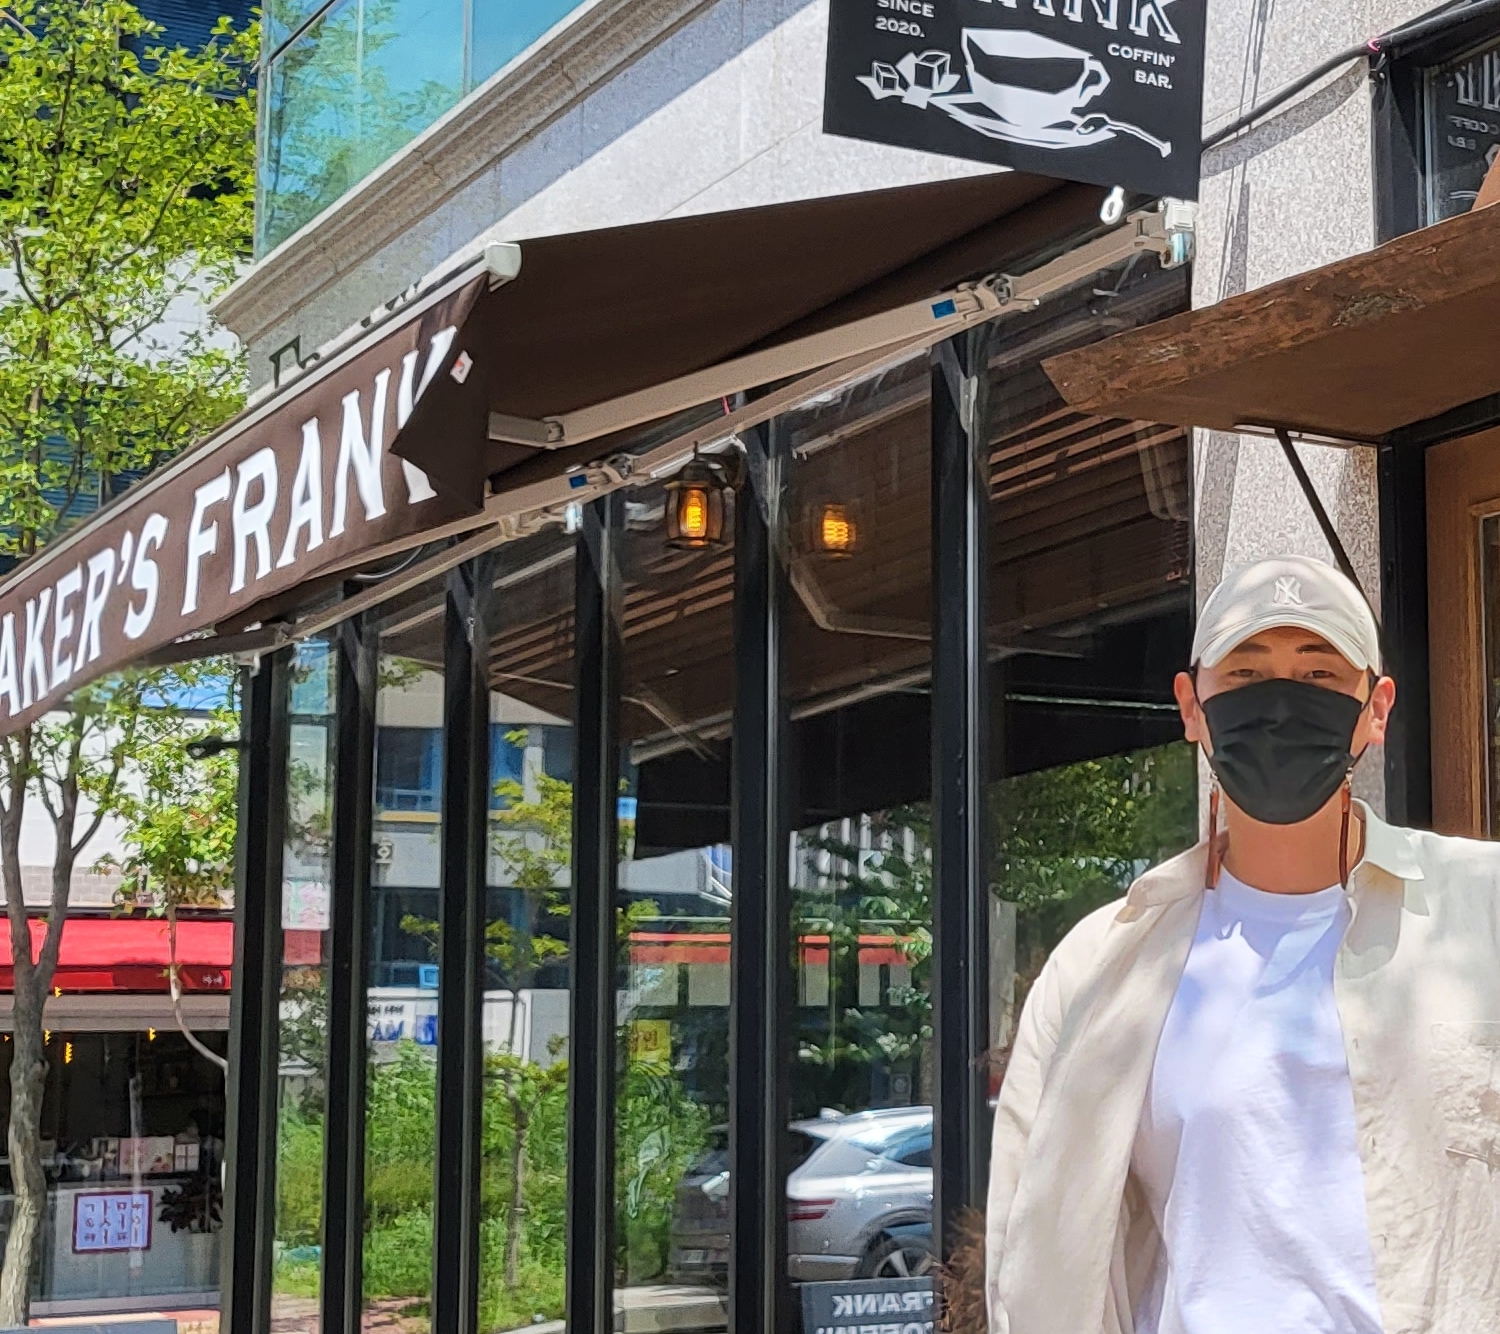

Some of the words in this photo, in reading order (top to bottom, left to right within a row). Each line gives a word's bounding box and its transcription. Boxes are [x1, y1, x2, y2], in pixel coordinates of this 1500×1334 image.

[875, 17, 925, 38] 2020.
[1107, 43, 1176, 67] COFFIN'
[1133, 69, 1173, 89] BAR.
